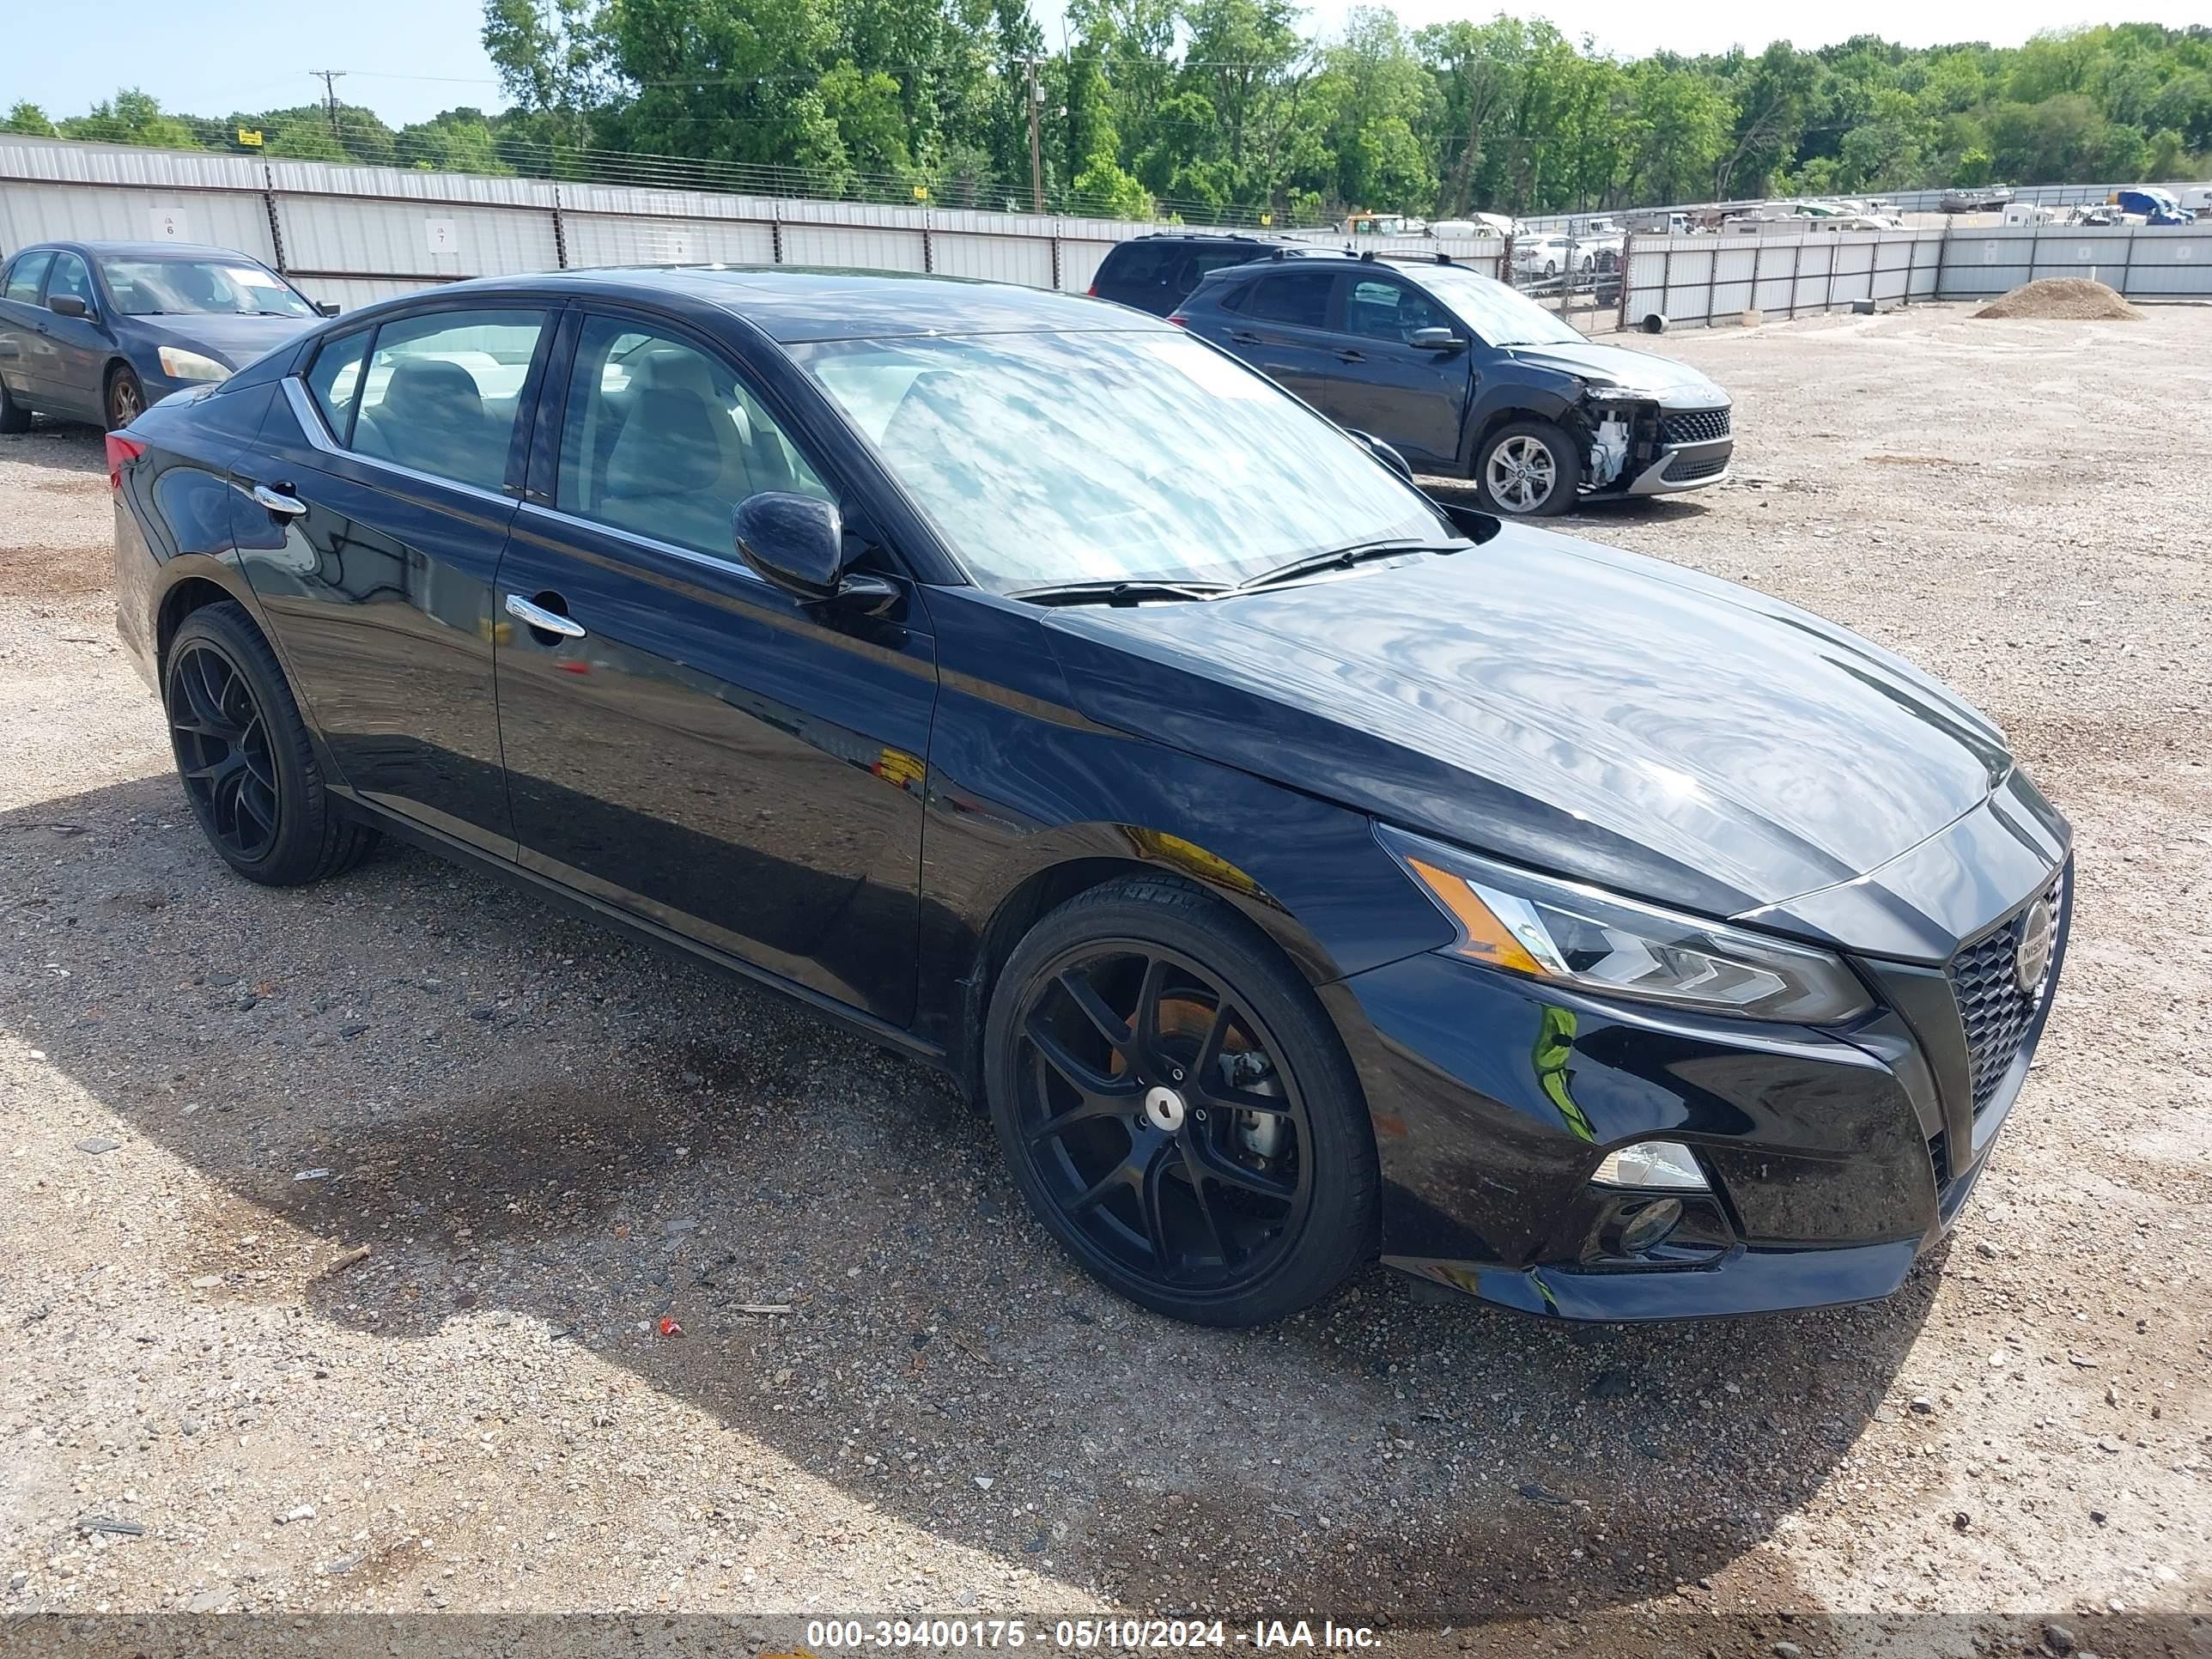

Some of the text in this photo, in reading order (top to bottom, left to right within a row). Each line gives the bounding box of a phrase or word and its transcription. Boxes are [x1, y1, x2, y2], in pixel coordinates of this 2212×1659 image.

[167, 226, 174, 234] 6
[439, 234, 445, 243] 7
[2023, 932, 2049, 960] NISS
